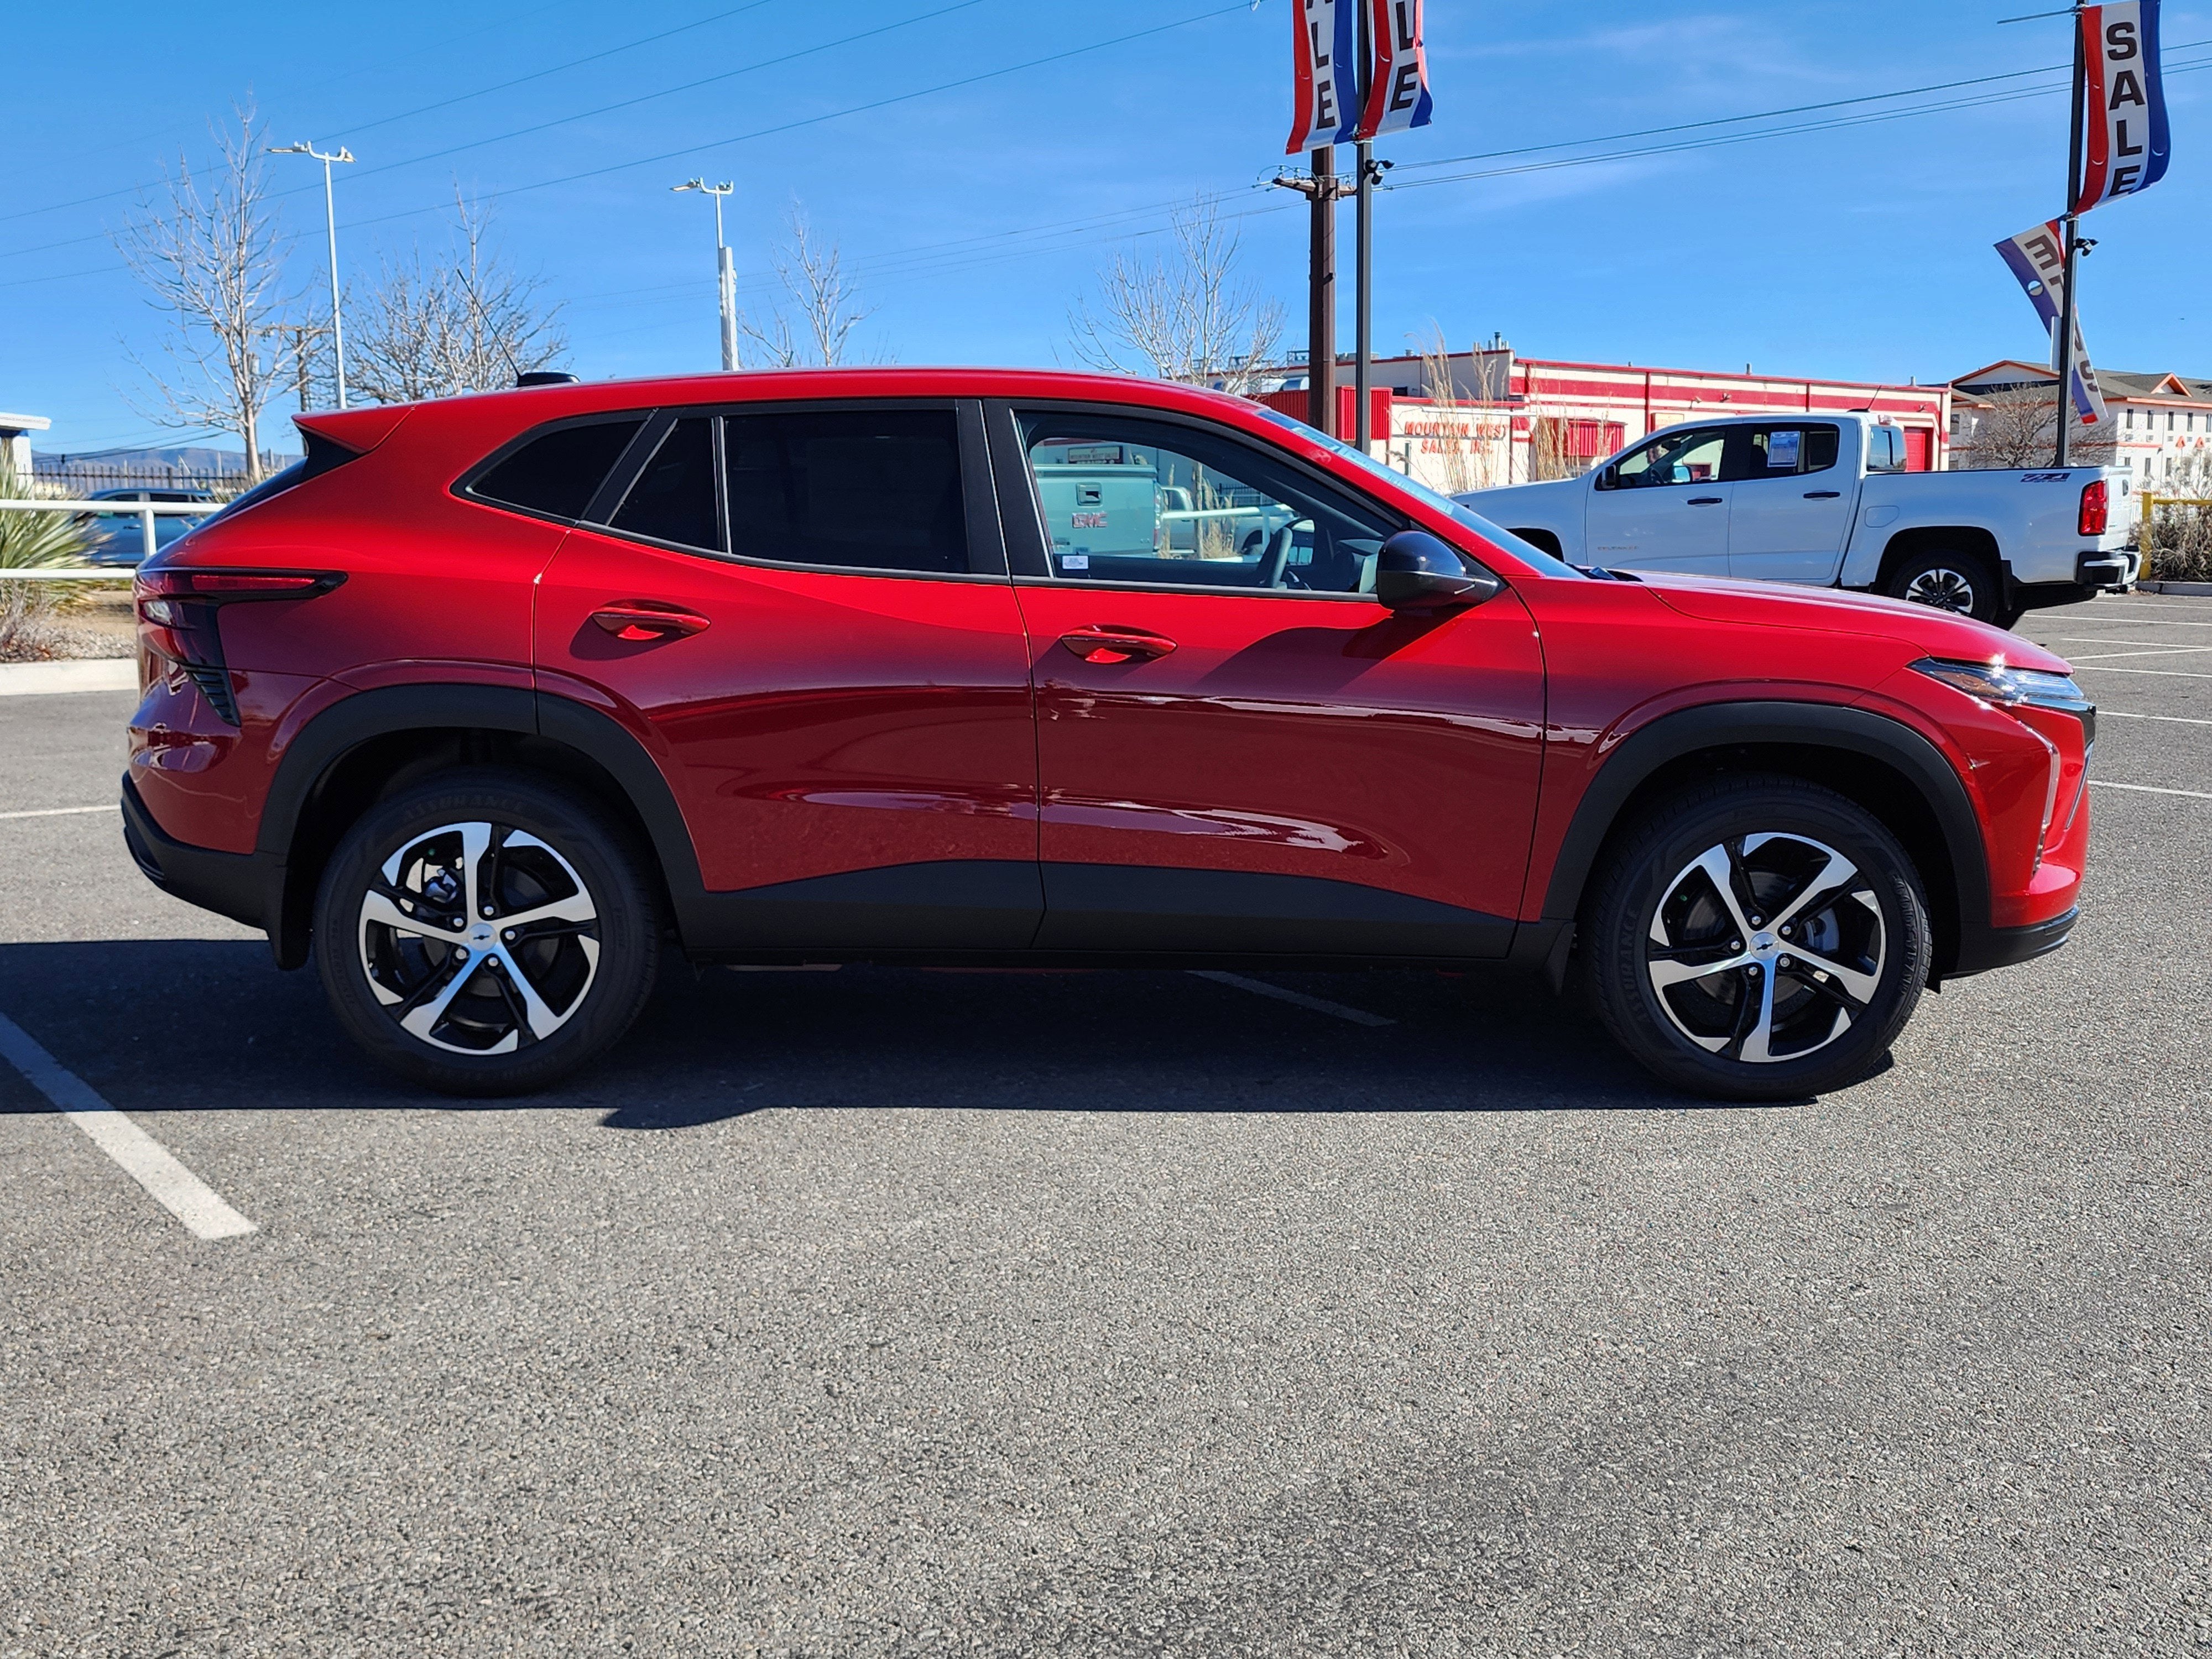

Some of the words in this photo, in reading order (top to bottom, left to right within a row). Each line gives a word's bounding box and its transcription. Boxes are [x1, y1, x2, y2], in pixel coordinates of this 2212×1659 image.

[1307, 0, 1336, 130] LE
[2106, 22, 2146, 197] SALE
[1477, 423, 1510, 438] WEST
[1072, 512, 1108, 529] GMC
